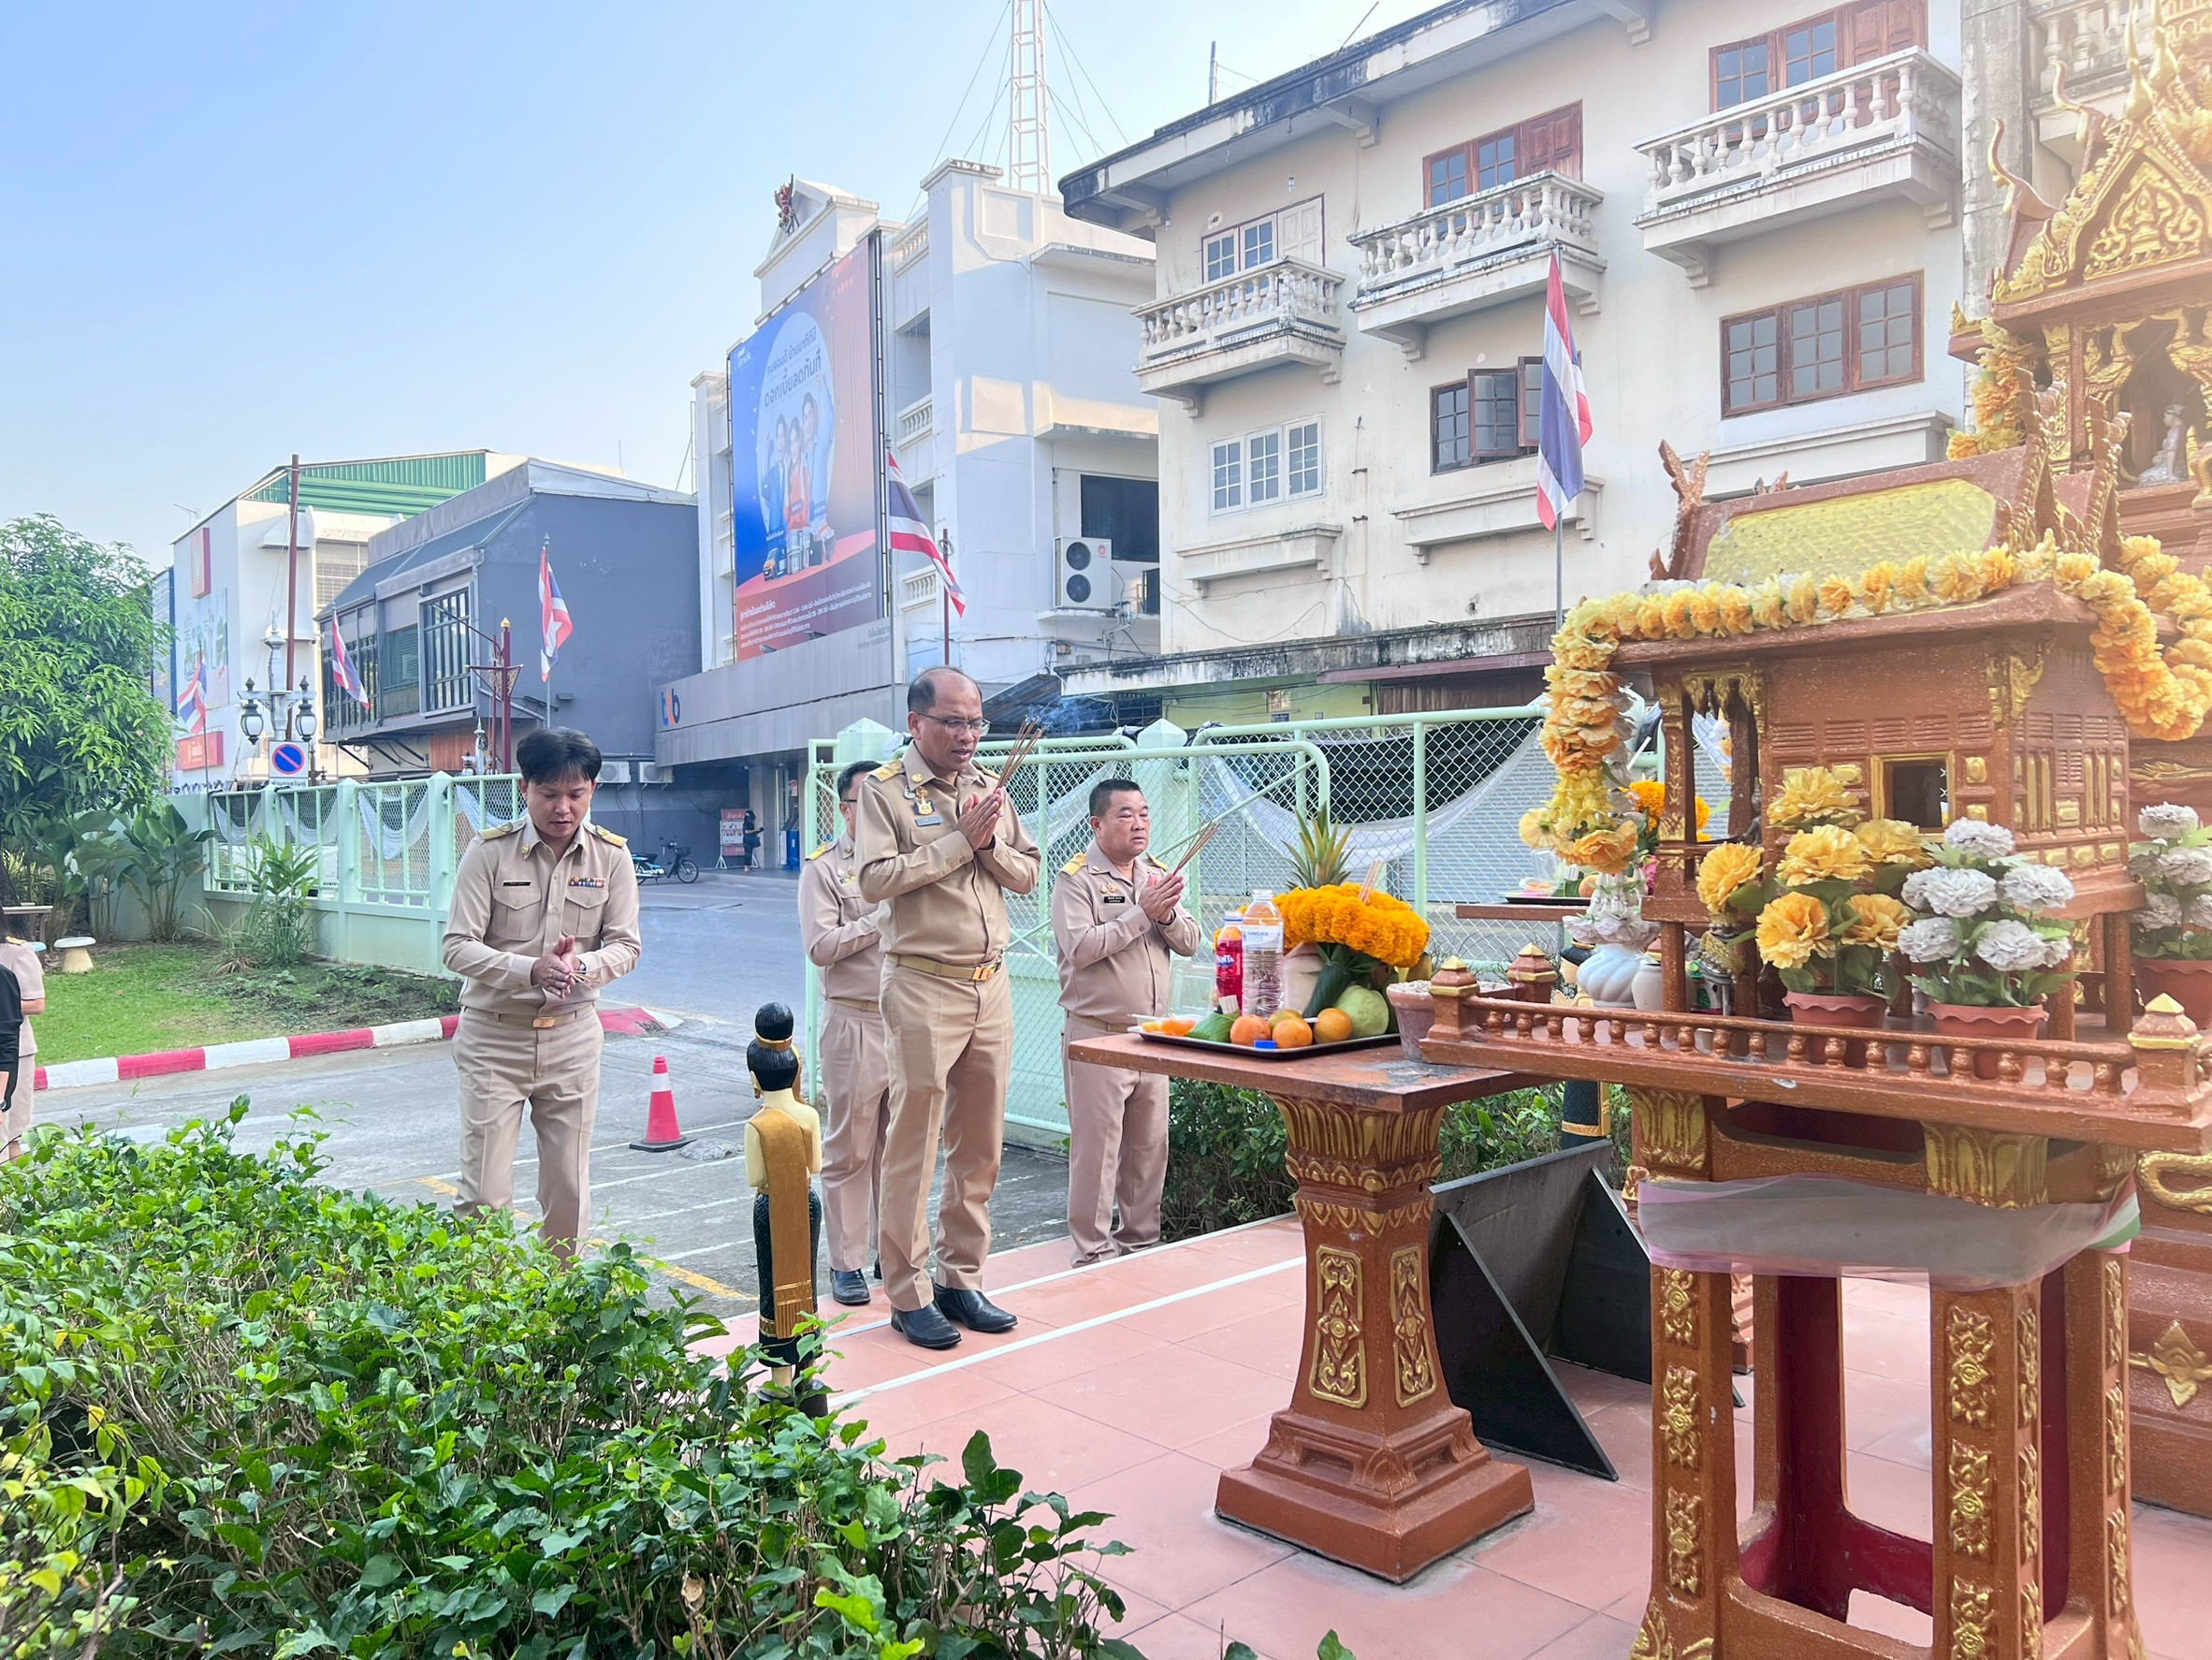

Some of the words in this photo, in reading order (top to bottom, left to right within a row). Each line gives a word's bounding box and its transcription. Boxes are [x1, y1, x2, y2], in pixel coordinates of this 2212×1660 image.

[764, 346, 822, 407] ดอกเบี้ยลดทันที
[661, 688, 680, 725] ttb
